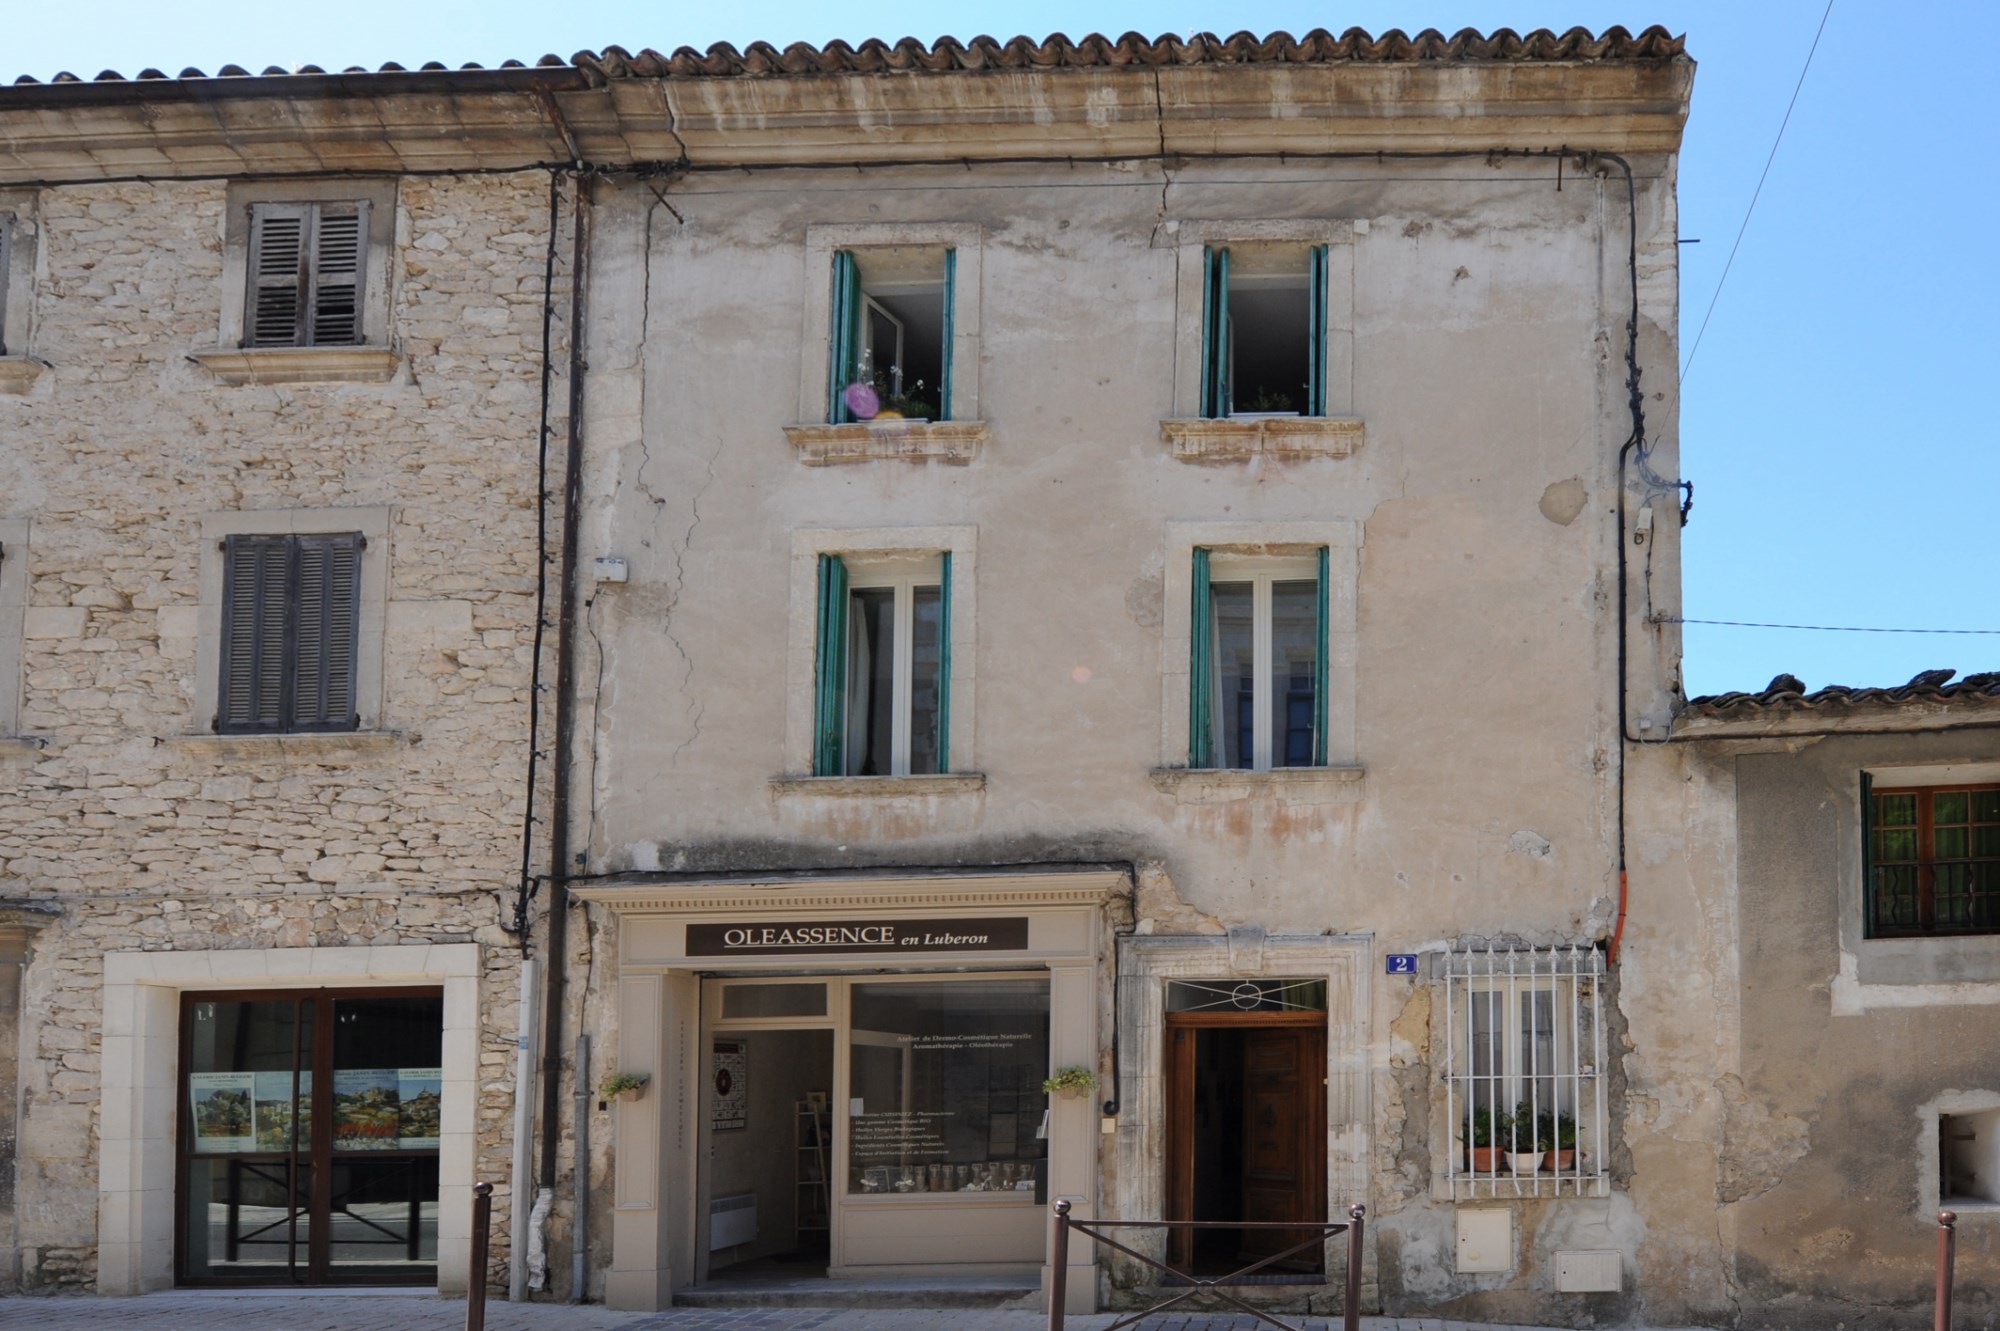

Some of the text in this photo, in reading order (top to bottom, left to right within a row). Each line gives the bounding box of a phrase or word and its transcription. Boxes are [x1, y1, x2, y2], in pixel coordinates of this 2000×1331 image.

[724, 927, 989, 947] OLEASSENCE en Luberon
[1396, 957, 1408, 971] 2
[912, 1042, 964, 1050] Aromathérapie
